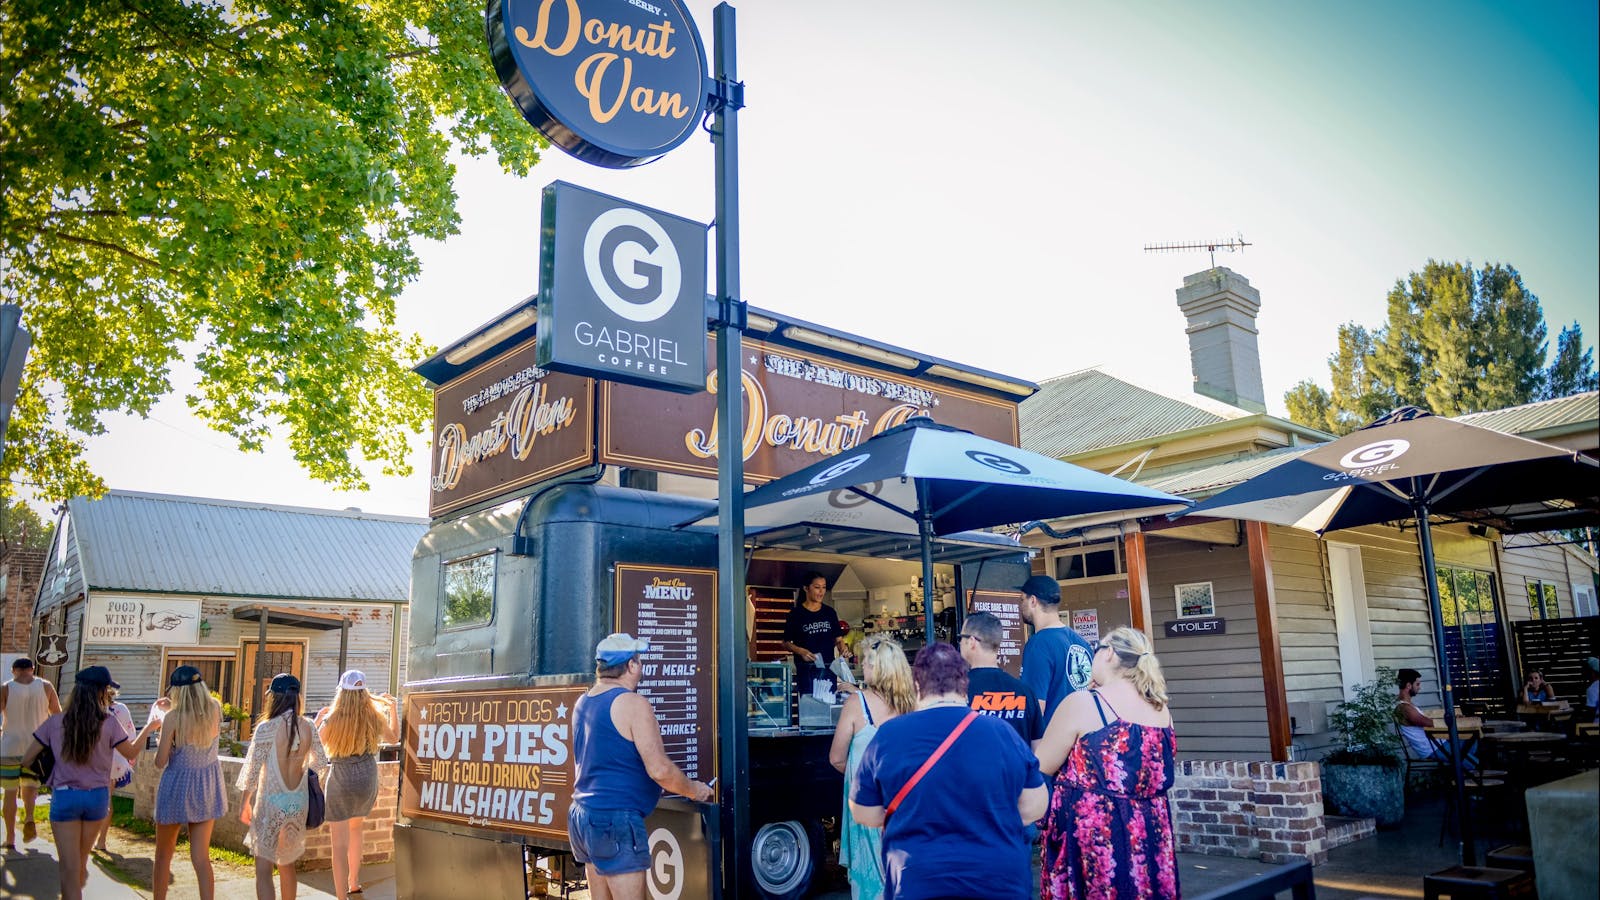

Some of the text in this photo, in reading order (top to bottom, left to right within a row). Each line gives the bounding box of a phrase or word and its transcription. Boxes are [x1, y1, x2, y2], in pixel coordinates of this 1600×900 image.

[628, 0, 662, 16] BERRY
[514, 0, 677, 59] Donut
[574, 52, 690, 124] Van
[574, 321, 688, 366] GABRIEL
[598, 354, 668, 375] COFFEE
[685, 368, 868, 463] Donut
[432, 382, 577, 493] Donut Van
[1322, 463, 1400, 480] GABRIEL
[645, 585, 692, 600] MENU
[108, 602, 136, 612] FOOD
[974, 602, 990, 611] PLEASE
[105, 614, 135, 624] WINE
[1178, 621, 1218, 632] TOILET
[92, 626, 134, 637] COFFEE
[662, 664, 696, 676] MEALS
[970, 691, 1026, 711] KTM
[427, 700, 552, 722] TASTY HOT DOGS
[979, 710, 1025, 719] ACING
[660, 724, 696, 735] SHAKES
[416, 724, 569, 766] HOT PIES
[431, 760, 540, 790] HOT & COLD DRINKS
[420, 780, 556, 826] MILKSHAKES
